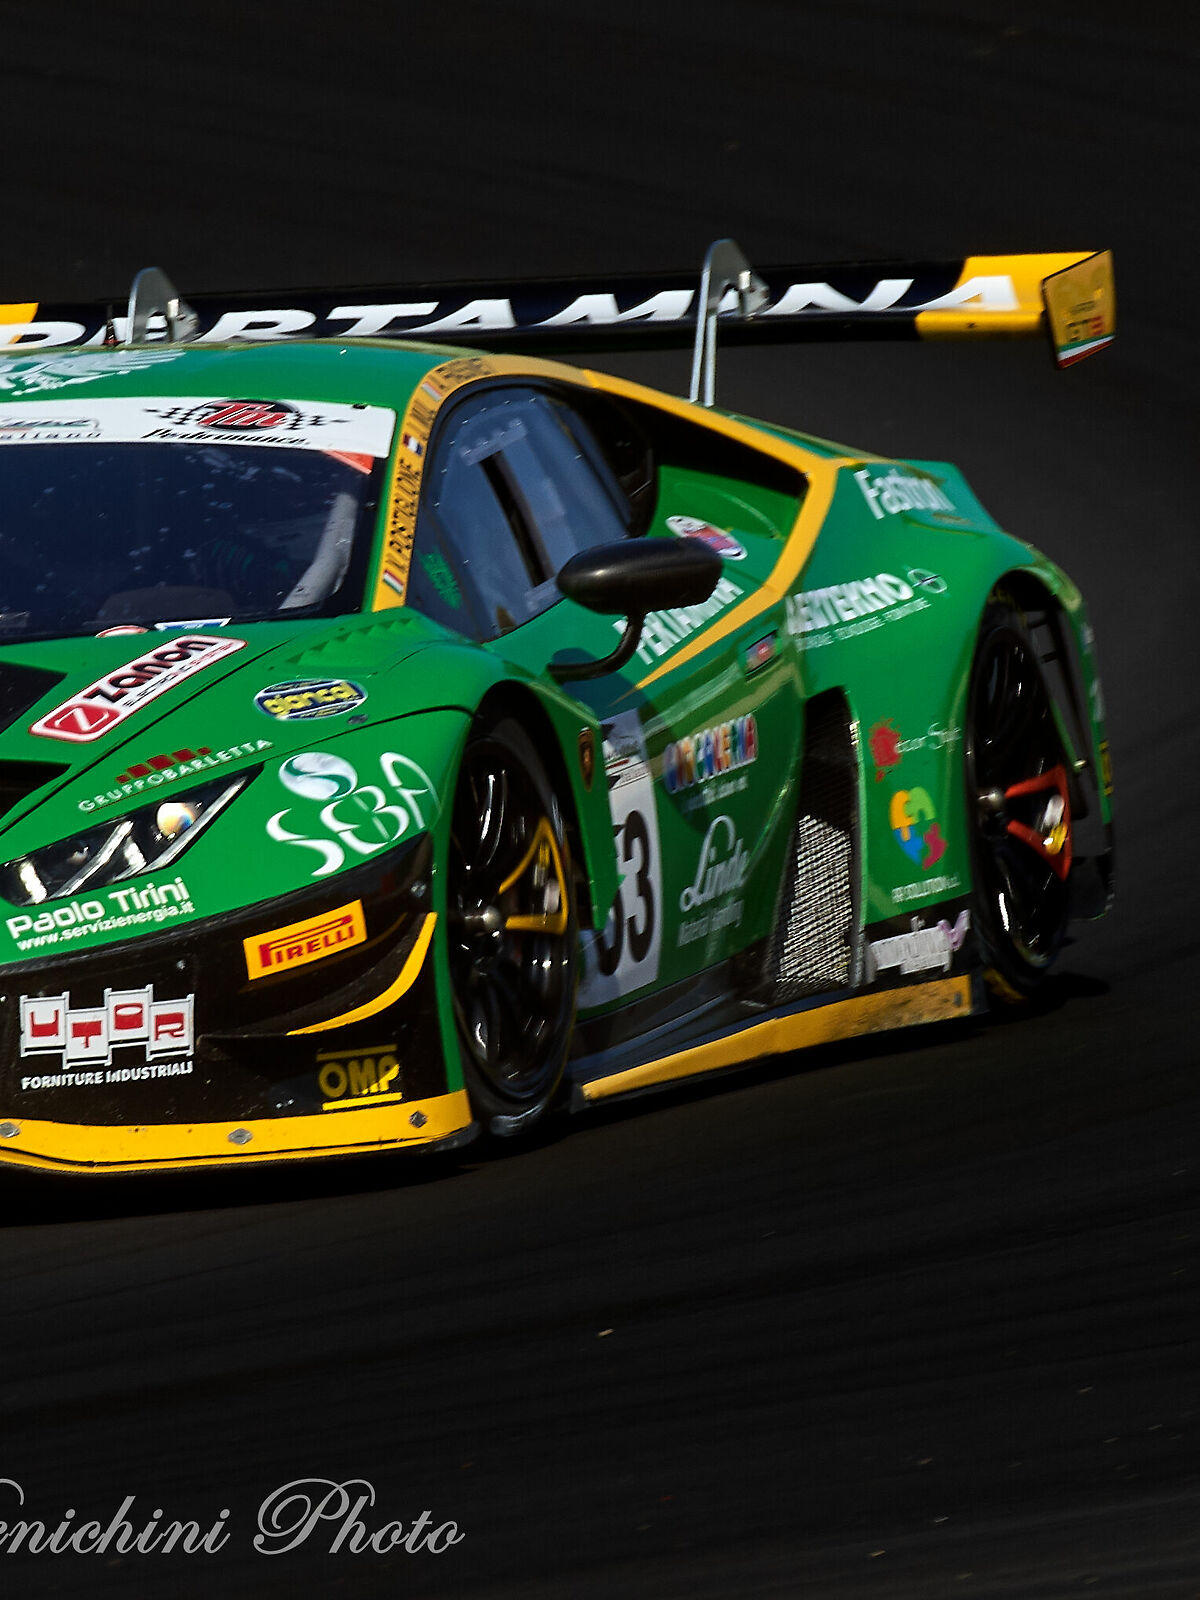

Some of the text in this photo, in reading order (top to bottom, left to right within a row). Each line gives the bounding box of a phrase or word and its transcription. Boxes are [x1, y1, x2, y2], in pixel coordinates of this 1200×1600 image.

[77, 739, 274, 813] GRUPPOBARLETTA
[6, 876, 190, 939] Paolo Tirini
[16, 900, 196, 951] www.servizienergia.it
[257, 914, 355, 968] PIRELLI
[21, 1060, 194, 1090] FORNITURE INDUSTRIALI
[318, 1054, 400, 1097] OMP
